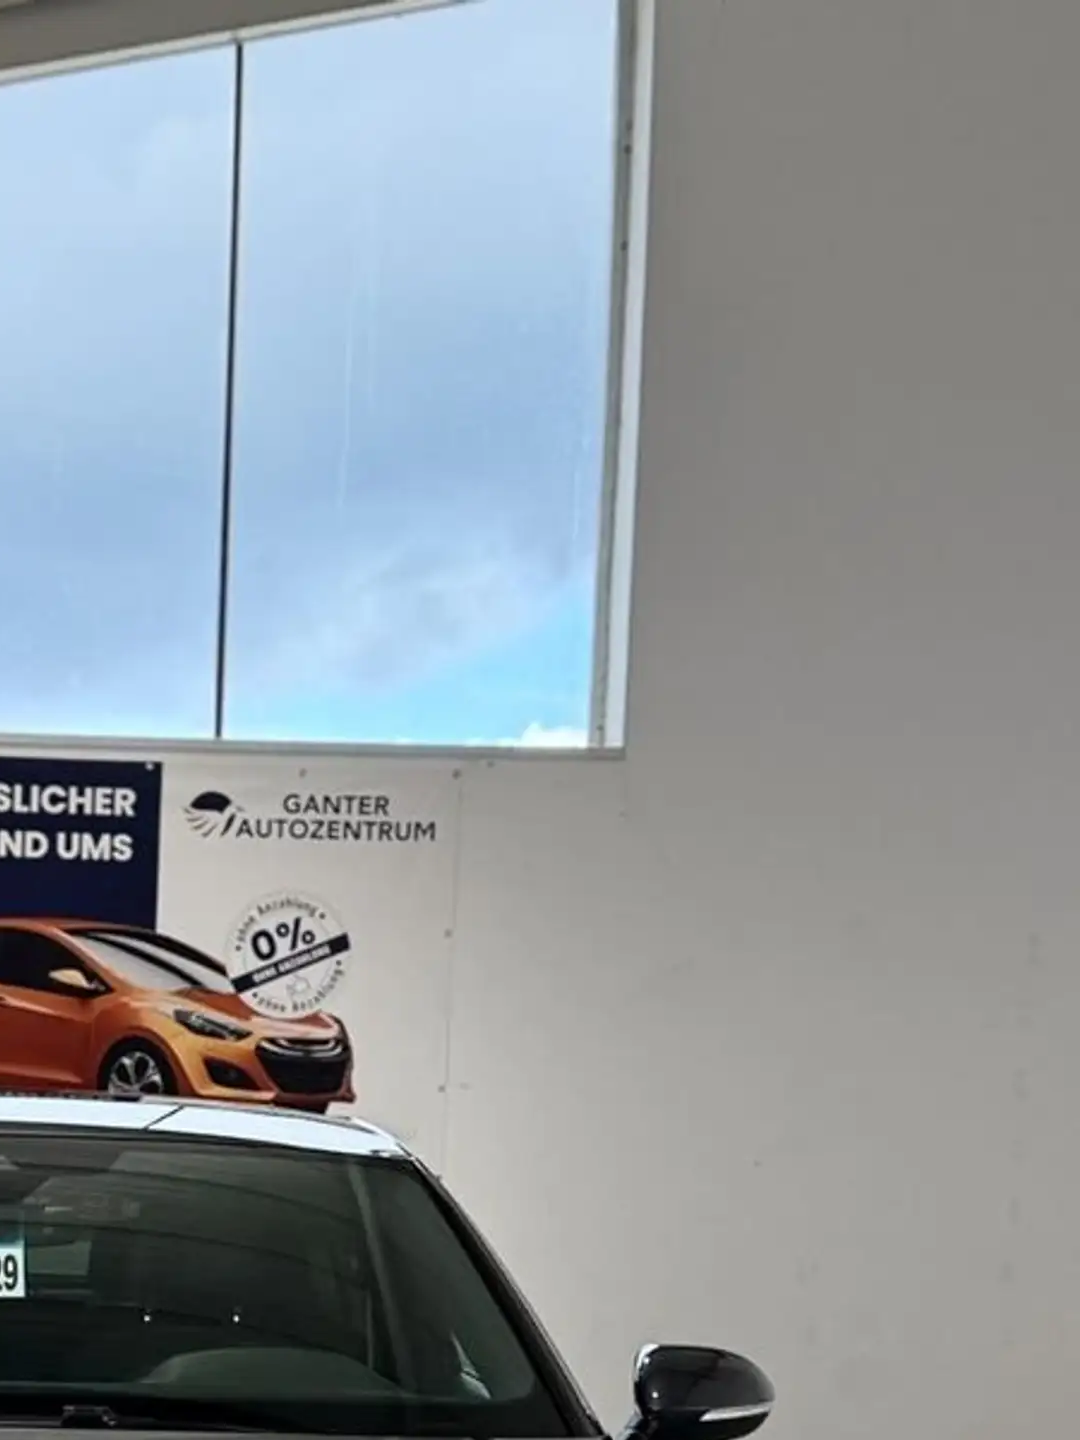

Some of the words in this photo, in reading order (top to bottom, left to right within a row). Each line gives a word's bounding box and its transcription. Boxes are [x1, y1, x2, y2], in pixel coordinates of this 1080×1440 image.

[282, 793, 390, 816] GANTER
[235, 818, 436, 842] AUTOZENTRUM
[57, 833, 134, 862] UMS
[251, 916, 316, 961] 0%
